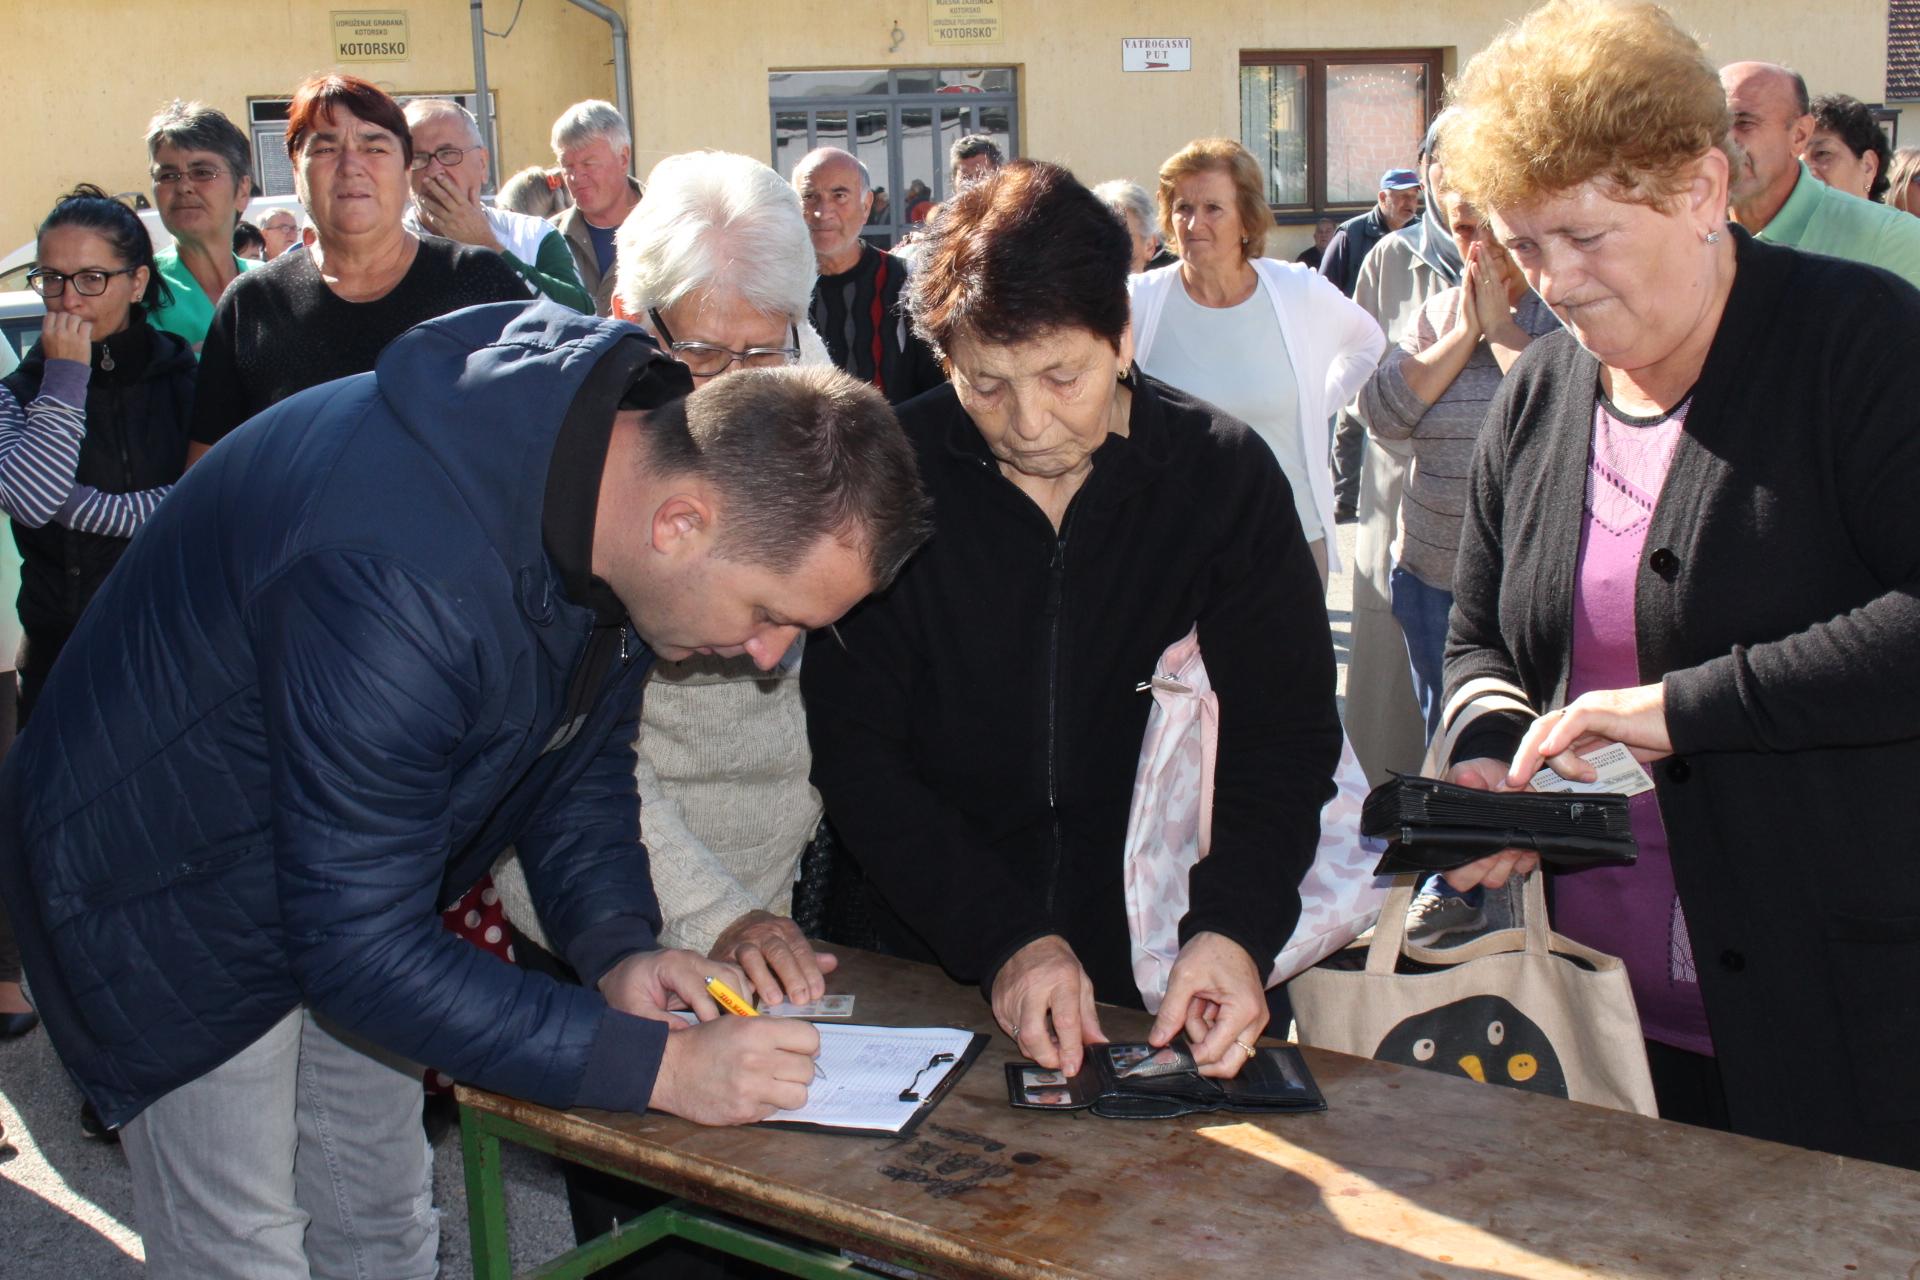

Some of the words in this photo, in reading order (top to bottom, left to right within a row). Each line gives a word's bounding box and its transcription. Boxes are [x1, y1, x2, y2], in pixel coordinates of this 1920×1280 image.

[340, 41, 406, 56] KOTORSKO
[1124, 39, 1189, 49] VATROGASNI
[1145, 50, 1169, 60] PUT
